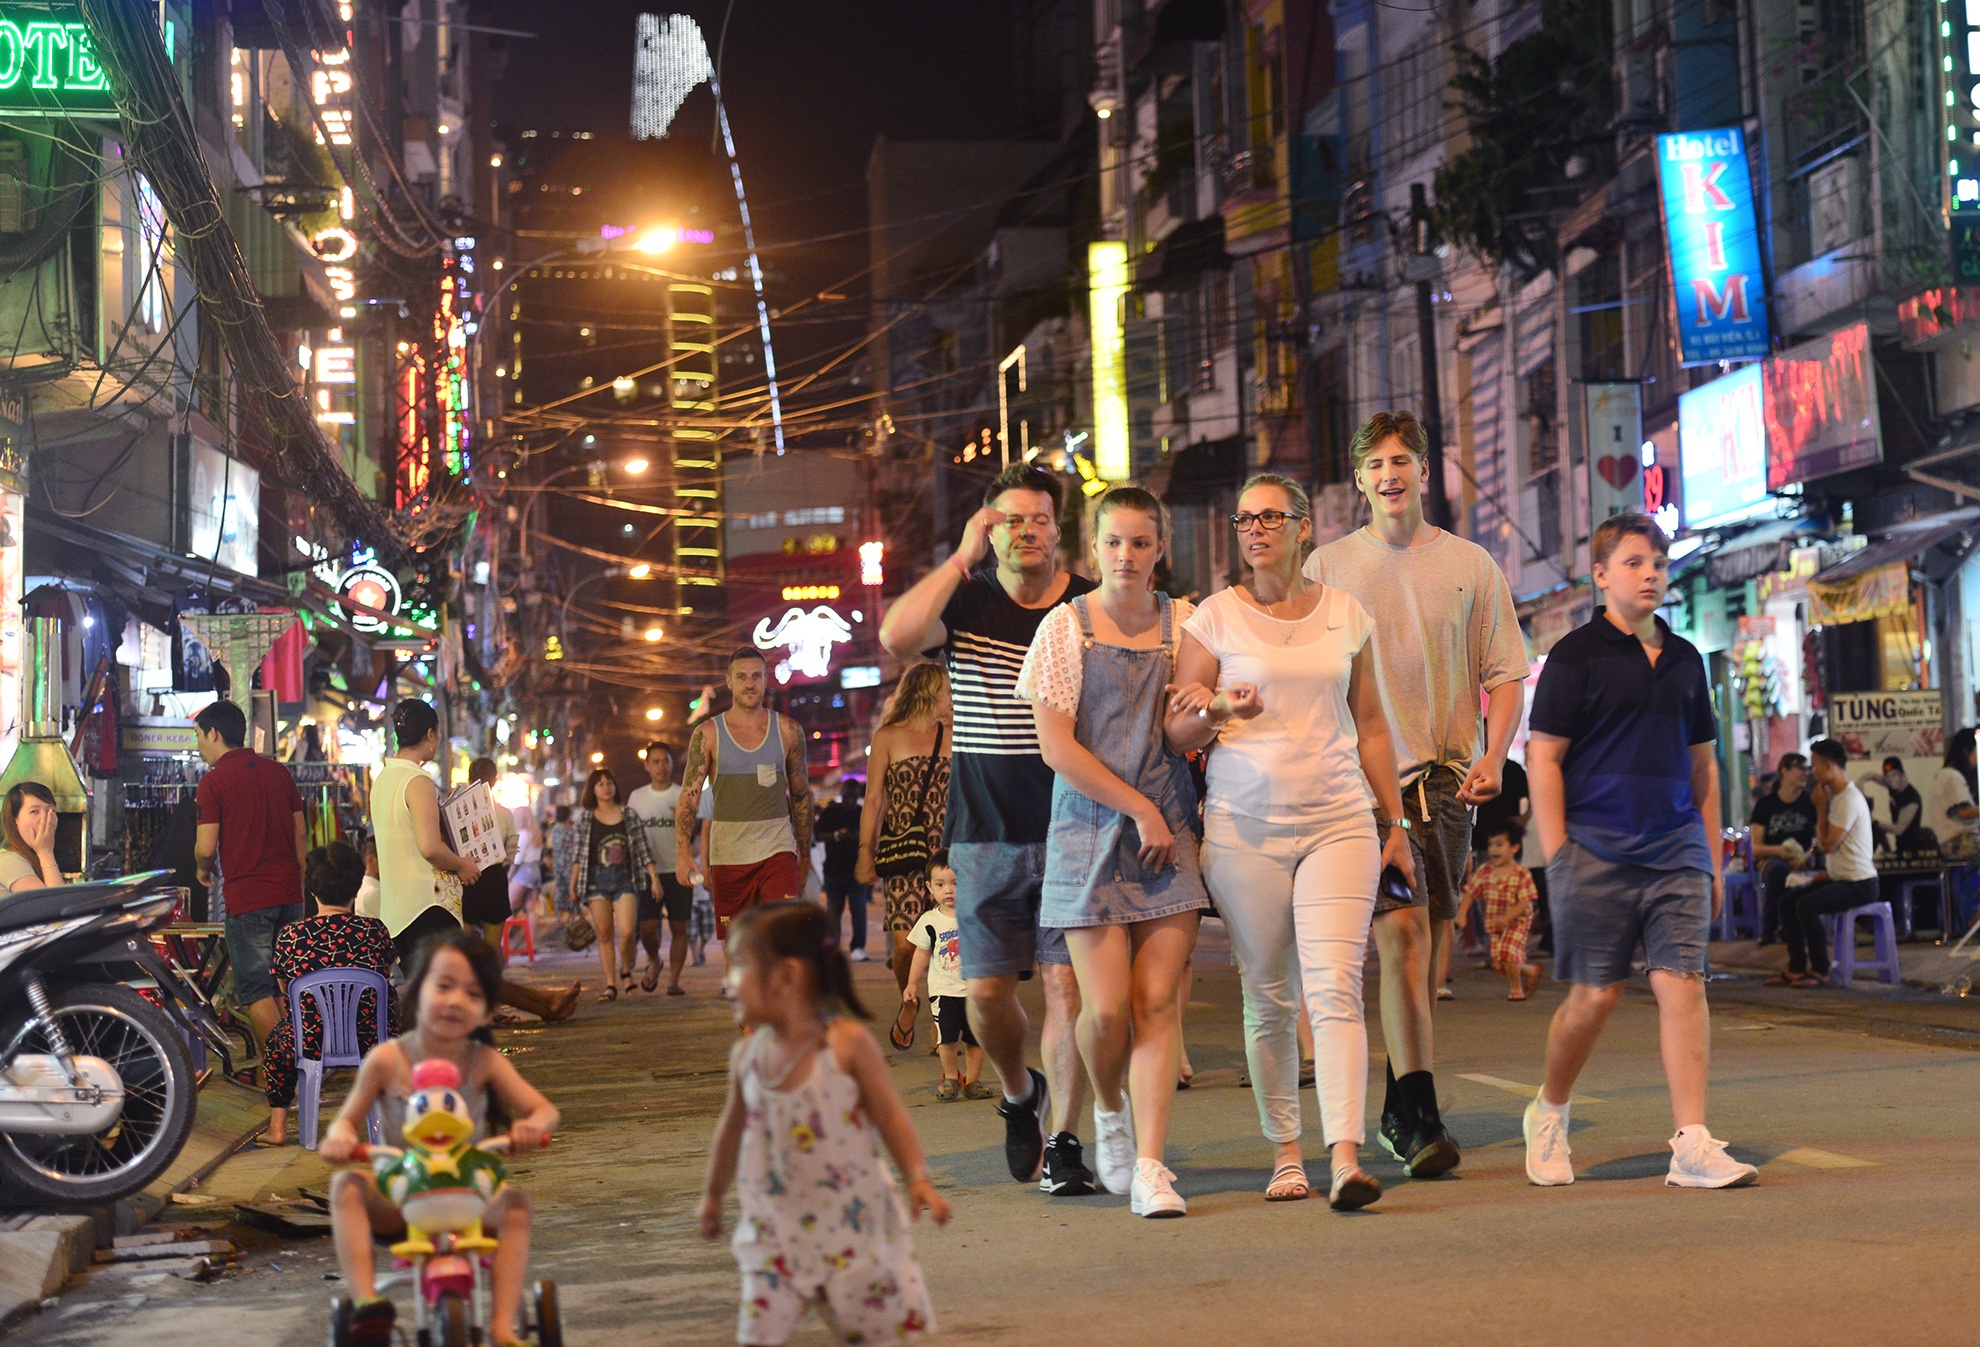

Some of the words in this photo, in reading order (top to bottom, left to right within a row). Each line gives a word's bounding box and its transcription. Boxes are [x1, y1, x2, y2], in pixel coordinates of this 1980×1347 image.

[0, 19, 110, 90] OTE
[1666, 130, 1740, 161] Hotel
[1681, 161, 1752, 327] KIM
[1833, 693, 1897, 720] TÙNG
[166, 733, 191, 744] KEBA
[641, 817, 676, 828] dida
